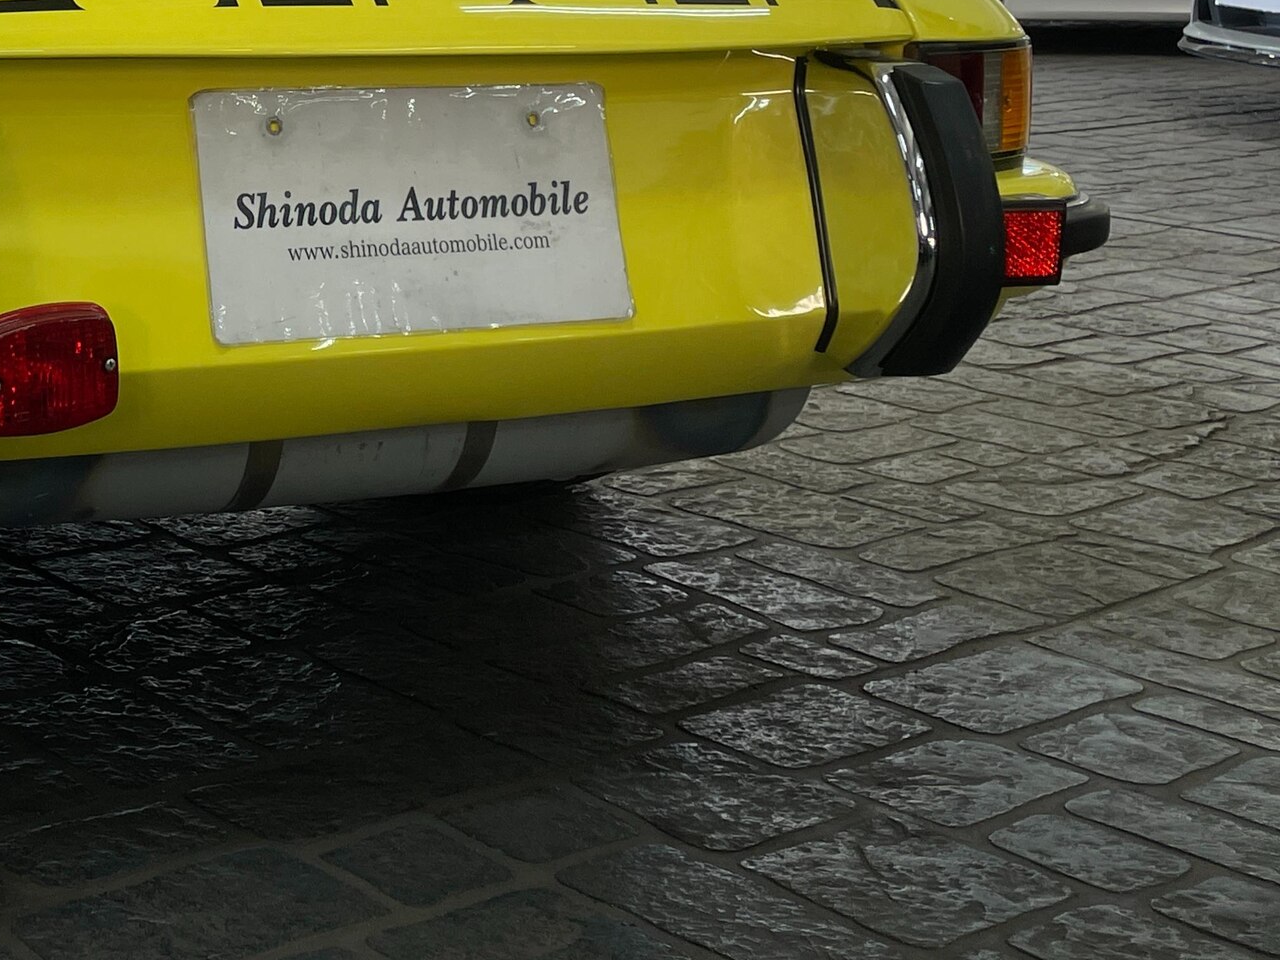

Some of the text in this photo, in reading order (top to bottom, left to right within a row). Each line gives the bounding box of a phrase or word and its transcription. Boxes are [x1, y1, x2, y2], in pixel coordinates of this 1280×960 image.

[233, 180, 590, 230] Shinoda Automobile
[287, 233, 551, 262] www.shinodaautomobile.com
